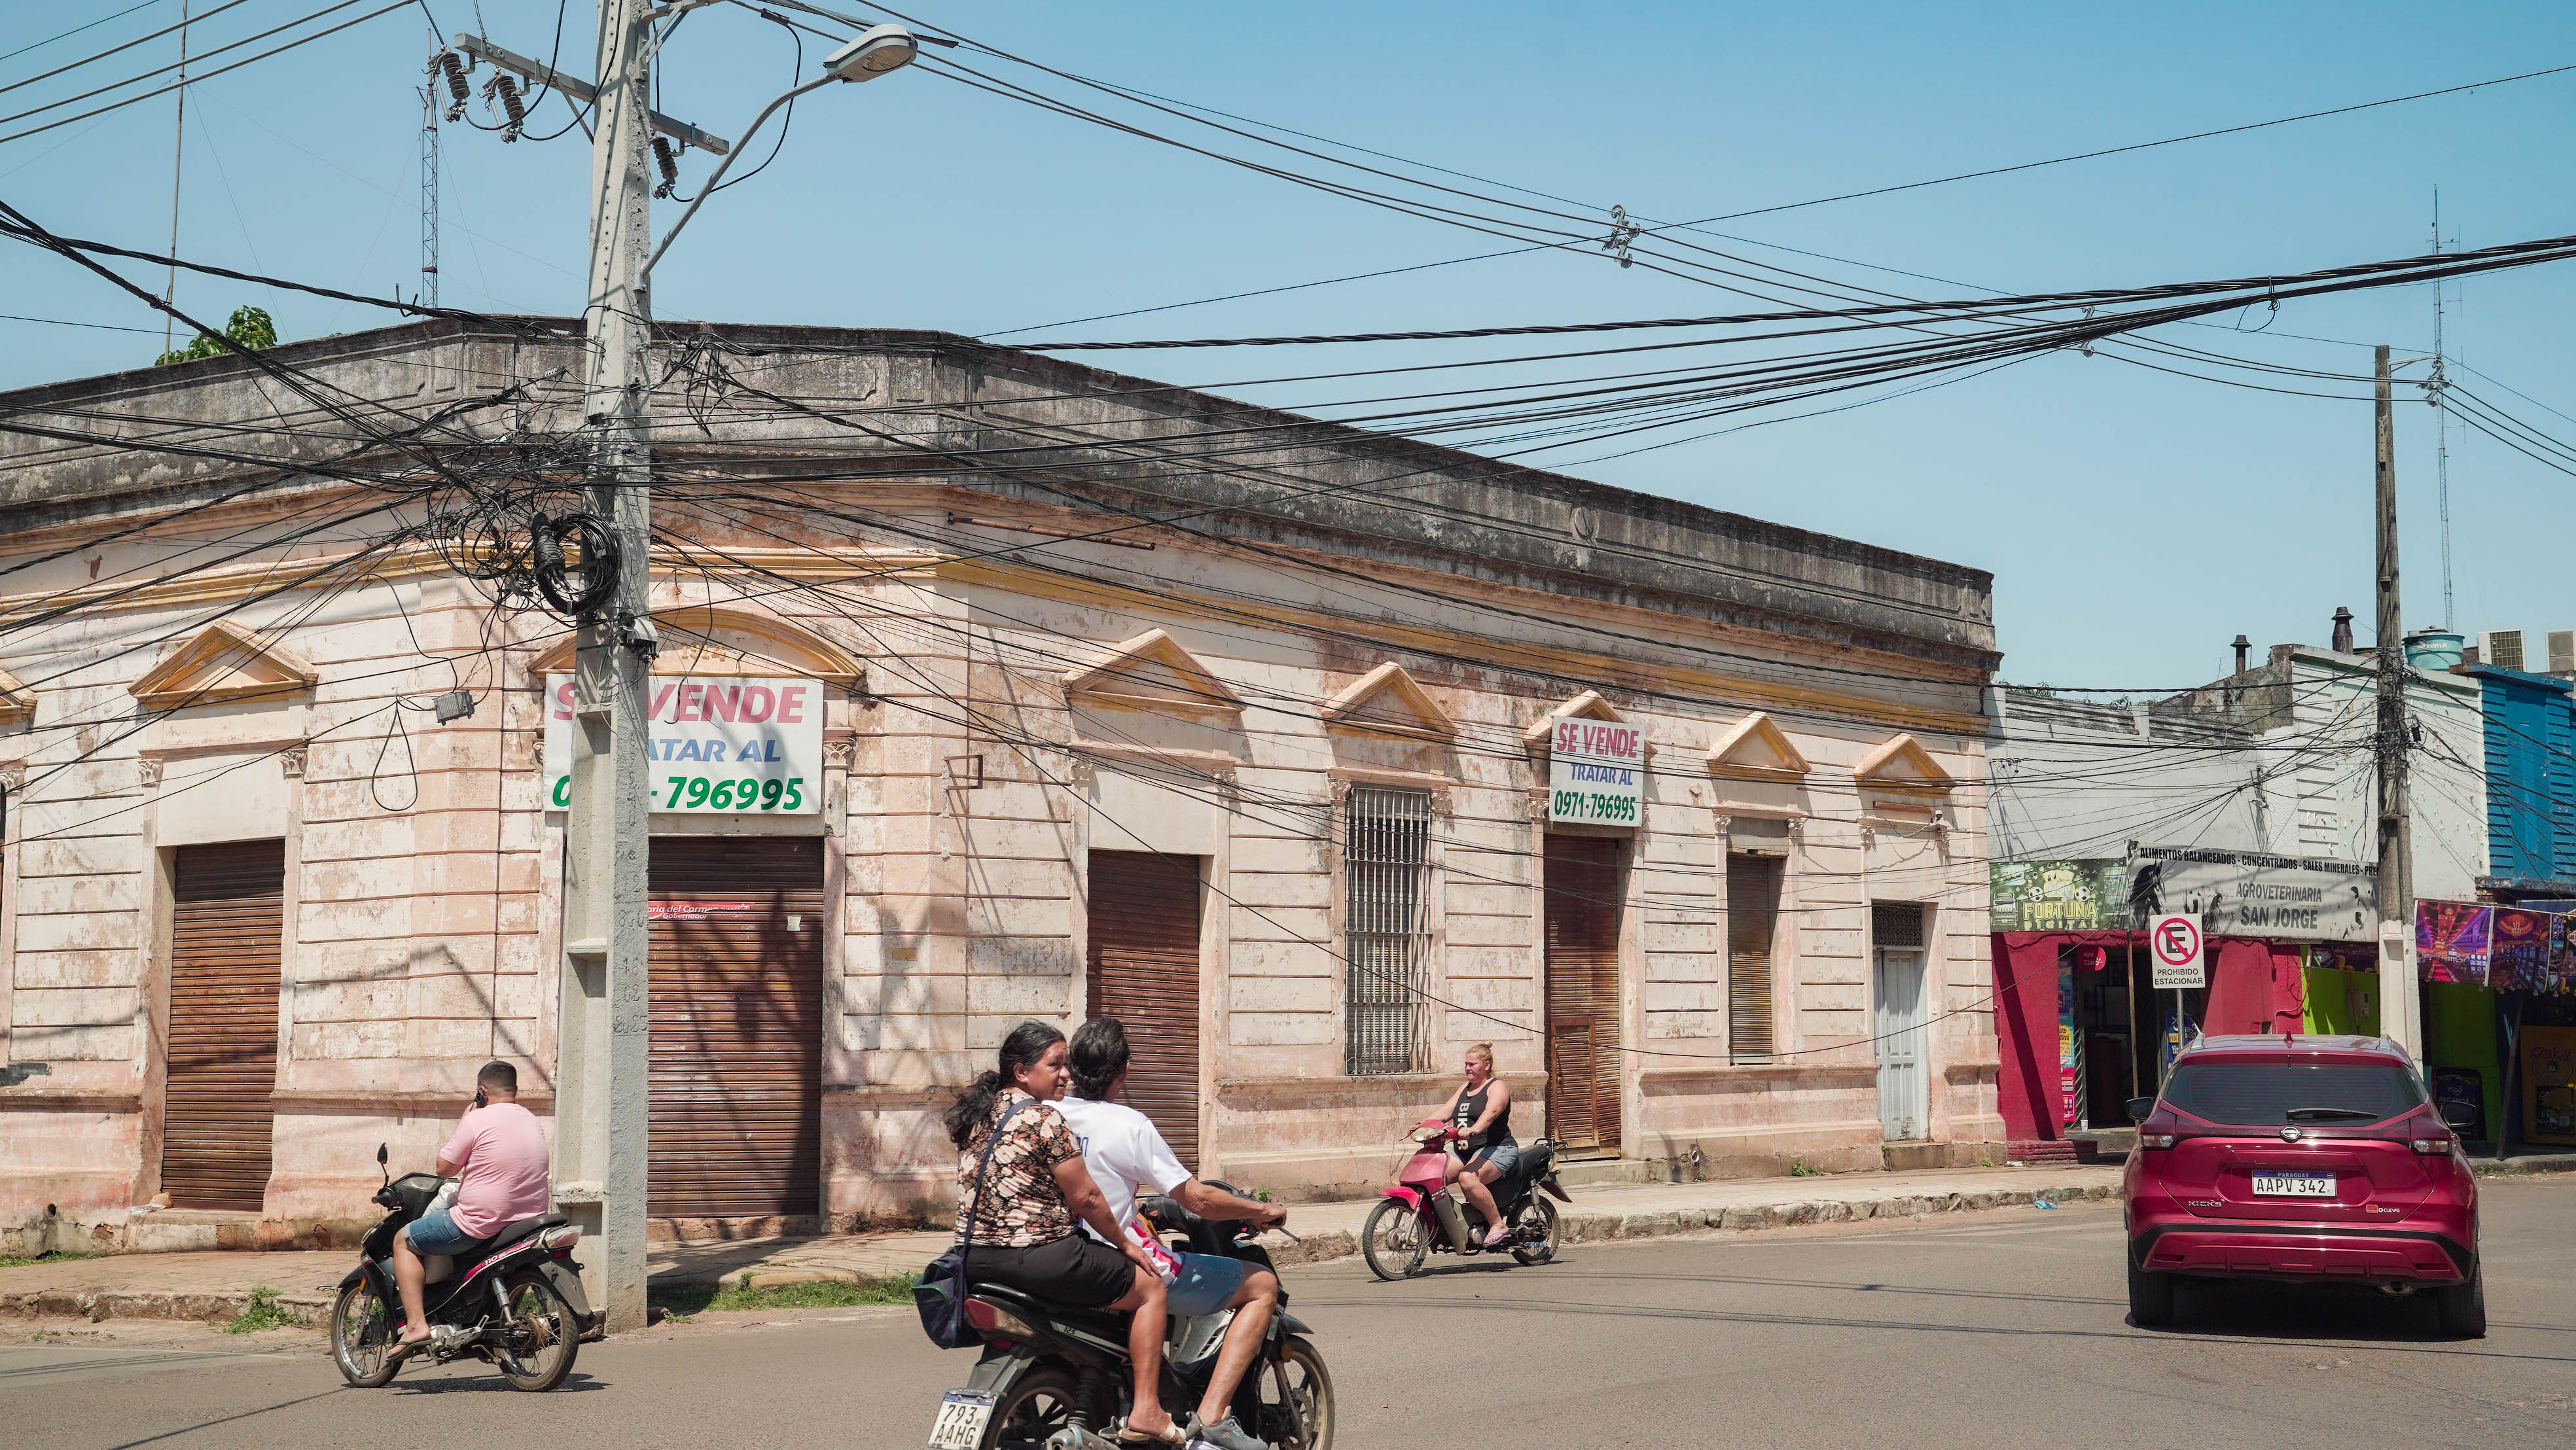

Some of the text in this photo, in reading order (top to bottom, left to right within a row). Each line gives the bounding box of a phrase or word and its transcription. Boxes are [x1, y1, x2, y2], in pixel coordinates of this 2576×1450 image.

[649, 684, 806, 724] VENDE
[736, 739, 781, 762] AL
[1556, 722, 1639, 758] SE VENDE
[1571, 764, 1634, 785] TRATAR AL
[1554, 790, 1636, 821] 0971-796995
[2140, 847, 2182, 861] ALIMENTOS
[2184, 850, 2236, 864] BALANCEADOS
[2242, 855, 2298, 870] CONCENTRADOS
[2303, 860, 2323, 872] SALES
[2324, 862, 2359, 875] MINERALES
[2236, 882, 2322, 902] AGROVETERINARIA
[2023, 901, 2099, 920] FORTUNA
[2240, 905, 2319, 929] SAN JORGE
[2024, 919, 2098, 929] DIGITAL
[1457, 1103, 1471, 1151] BIKR
[2257, 1178, 2325, 1193] AAPV 342
[1064, 1326, 1075, 1335] 125
[944, 1404, 978, 1424] 793
[935, 1423, 976, 1445] AAHG
